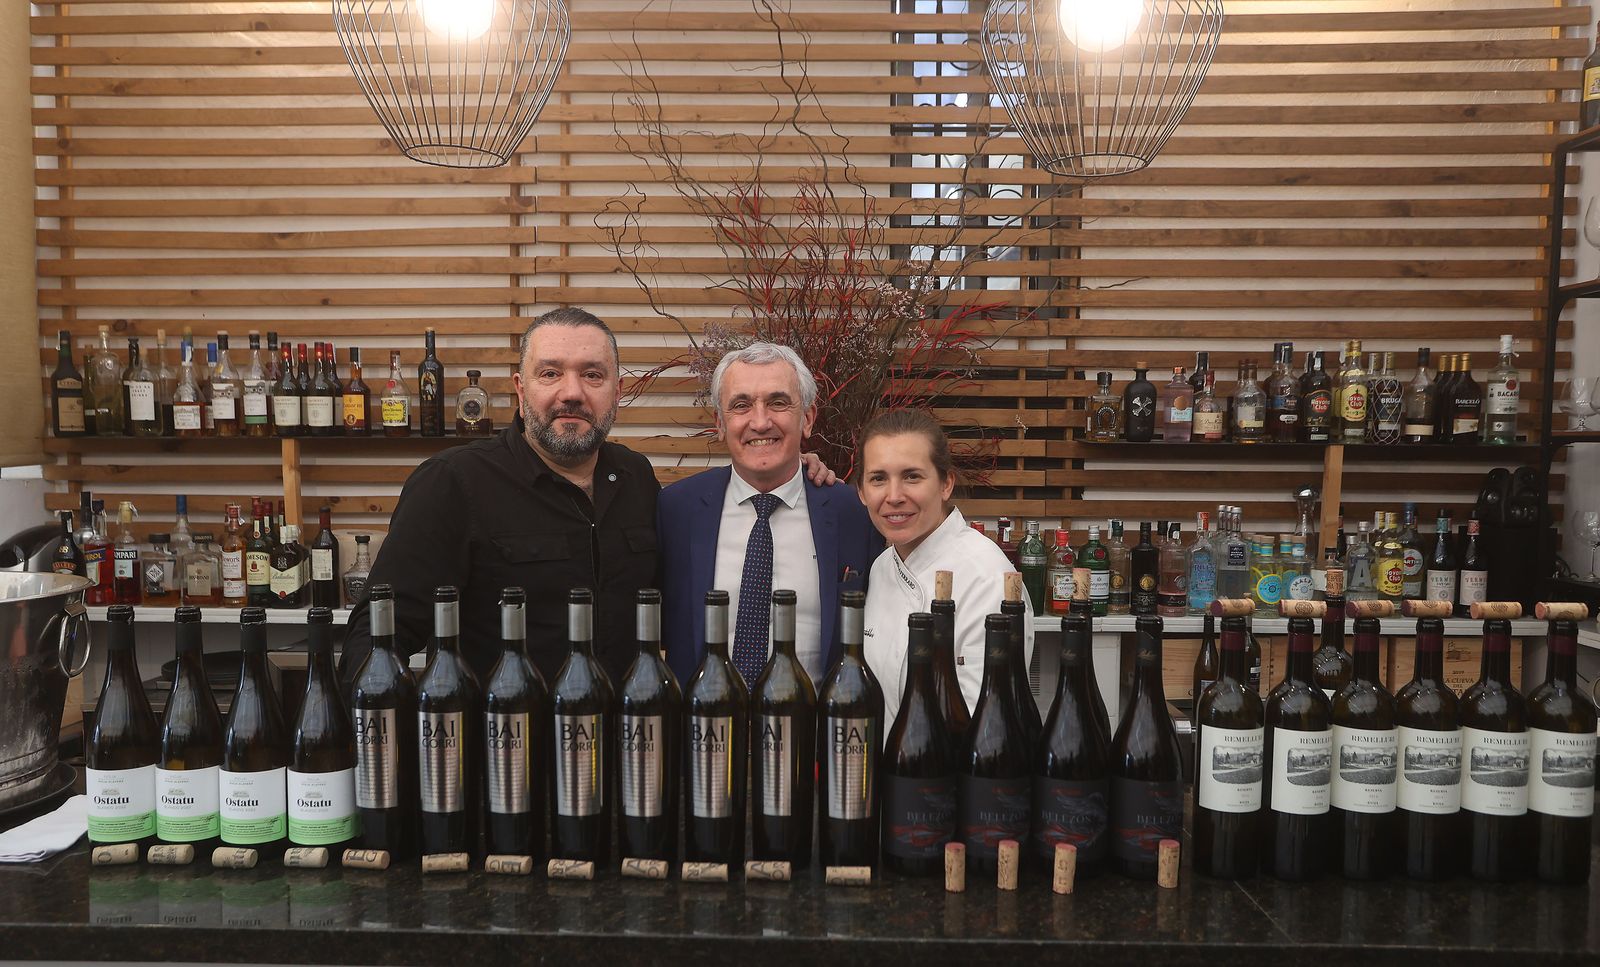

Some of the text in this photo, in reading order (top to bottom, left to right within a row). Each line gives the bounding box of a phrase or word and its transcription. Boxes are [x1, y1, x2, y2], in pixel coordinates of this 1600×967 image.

[355, 717, 387, 734] BAI
[422, 720, 455, 737] BAI
[488, 721, 521, 738] BAI
[562, 723, 595, 741] BAI
[623, 724, 653, 741] BAI
[692, 725, 725, 742] BAI
[762, 724, 783, 740] AI
[835, 727, 868, 743] BAI
[94, 796, 130, 805] Ostatu
[161, 795, 194, 805] Ostatu
[225, 797, 259, 807] Ostatu
[297, 798, 332, 808] Ostatu
